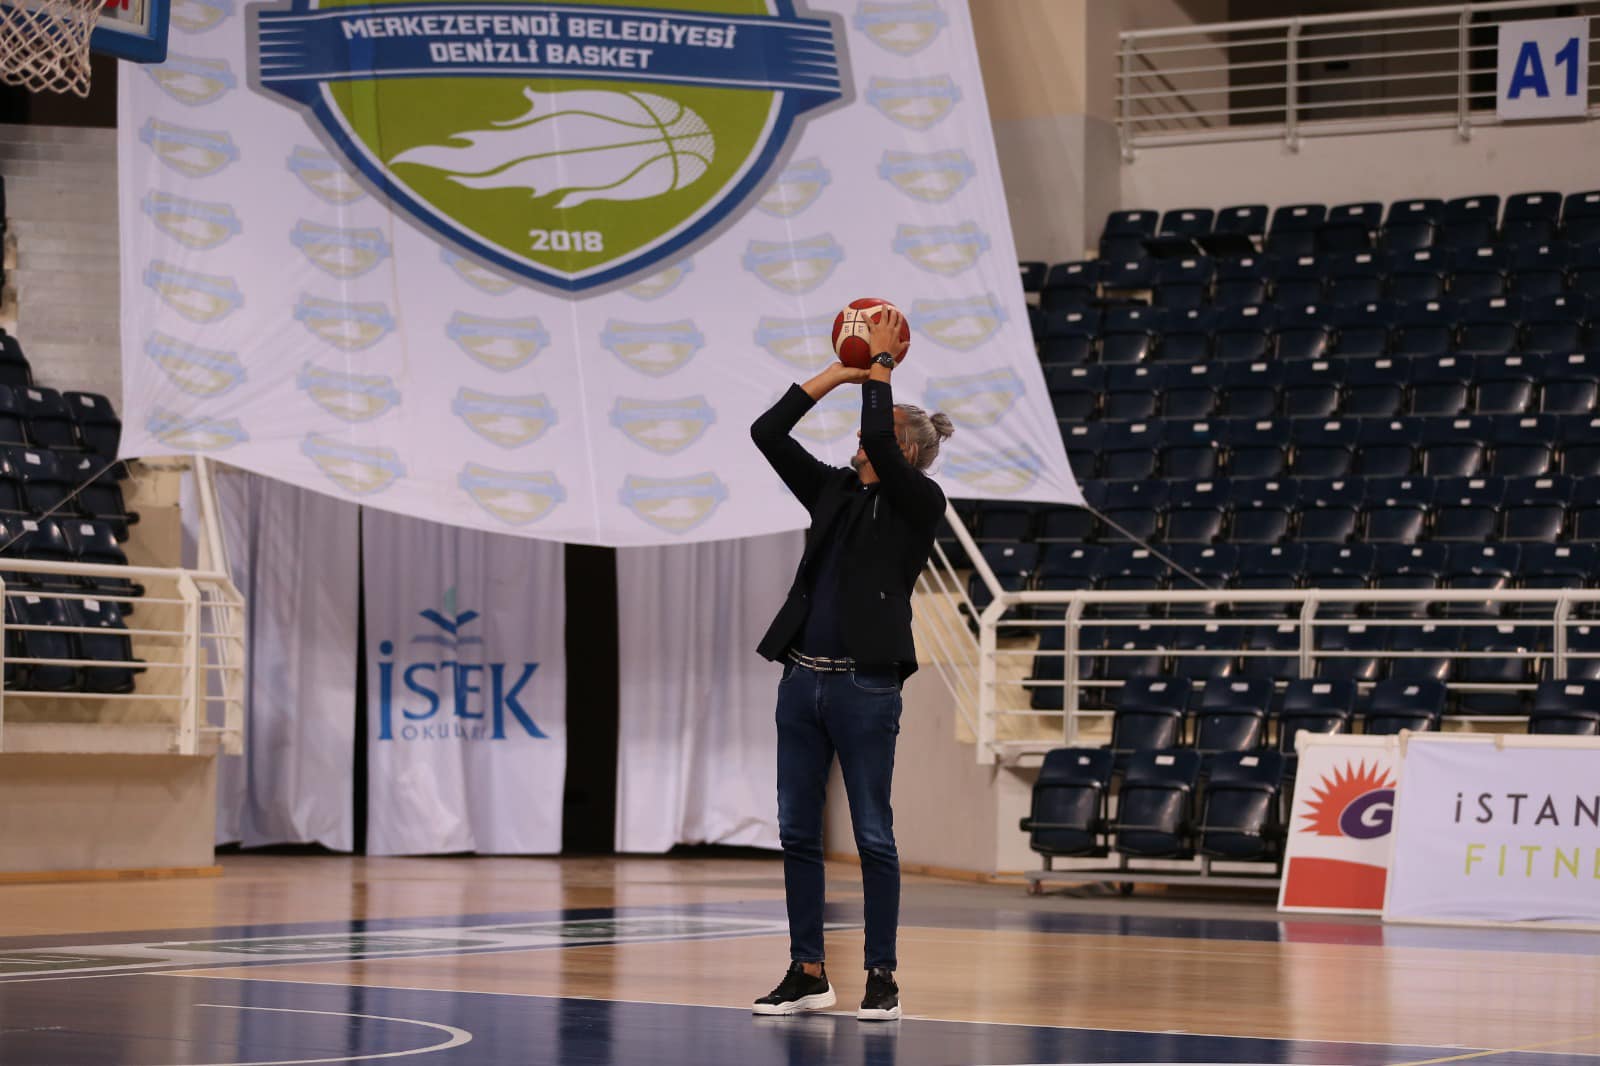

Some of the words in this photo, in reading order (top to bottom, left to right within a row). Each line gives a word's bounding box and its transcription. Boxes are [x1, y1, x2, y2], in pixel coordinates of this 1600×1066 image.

[341, 13, 560, 39] MERKEZEFENDİ
[567, 17, 737, 48] BELEDİYESİ
[429, 38, 539, 63] DENİZLİ
[546, 43, 653, 69] BASKET
[1507, 37, 1580, 99] A1
[529, 229, 604, 252] 2018
